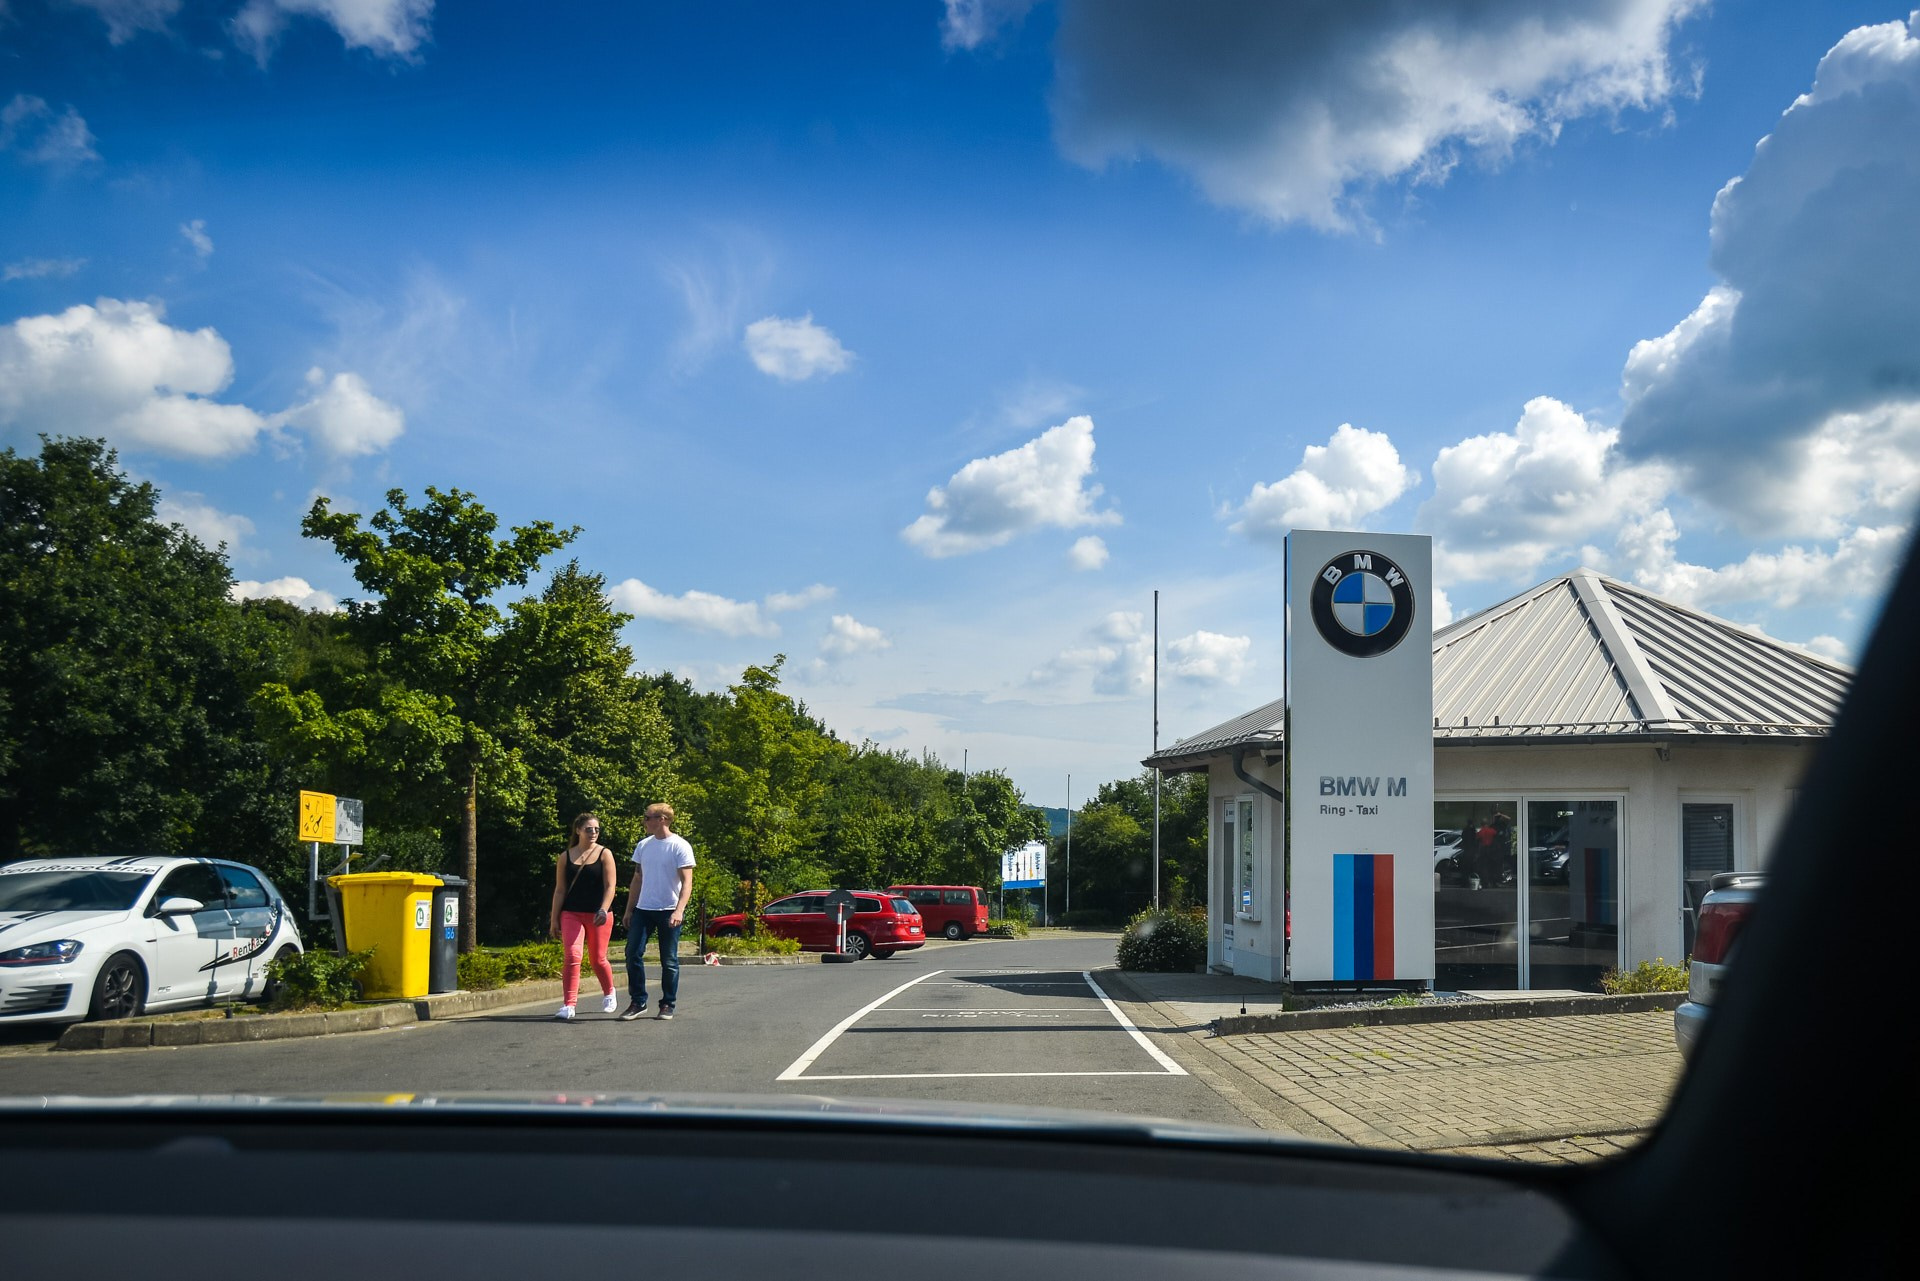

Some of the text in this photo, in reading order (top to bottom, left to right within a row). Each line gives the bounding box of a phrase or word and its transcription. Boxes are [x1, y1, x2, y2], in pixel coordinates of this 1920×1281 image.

[1322, 554, 1404, 588] BMW
[1320, 776, 1407, 797] BMW M
[1320, 804, 1346, 816] Ring
[1356, 805, 1378, 815] Taxi
